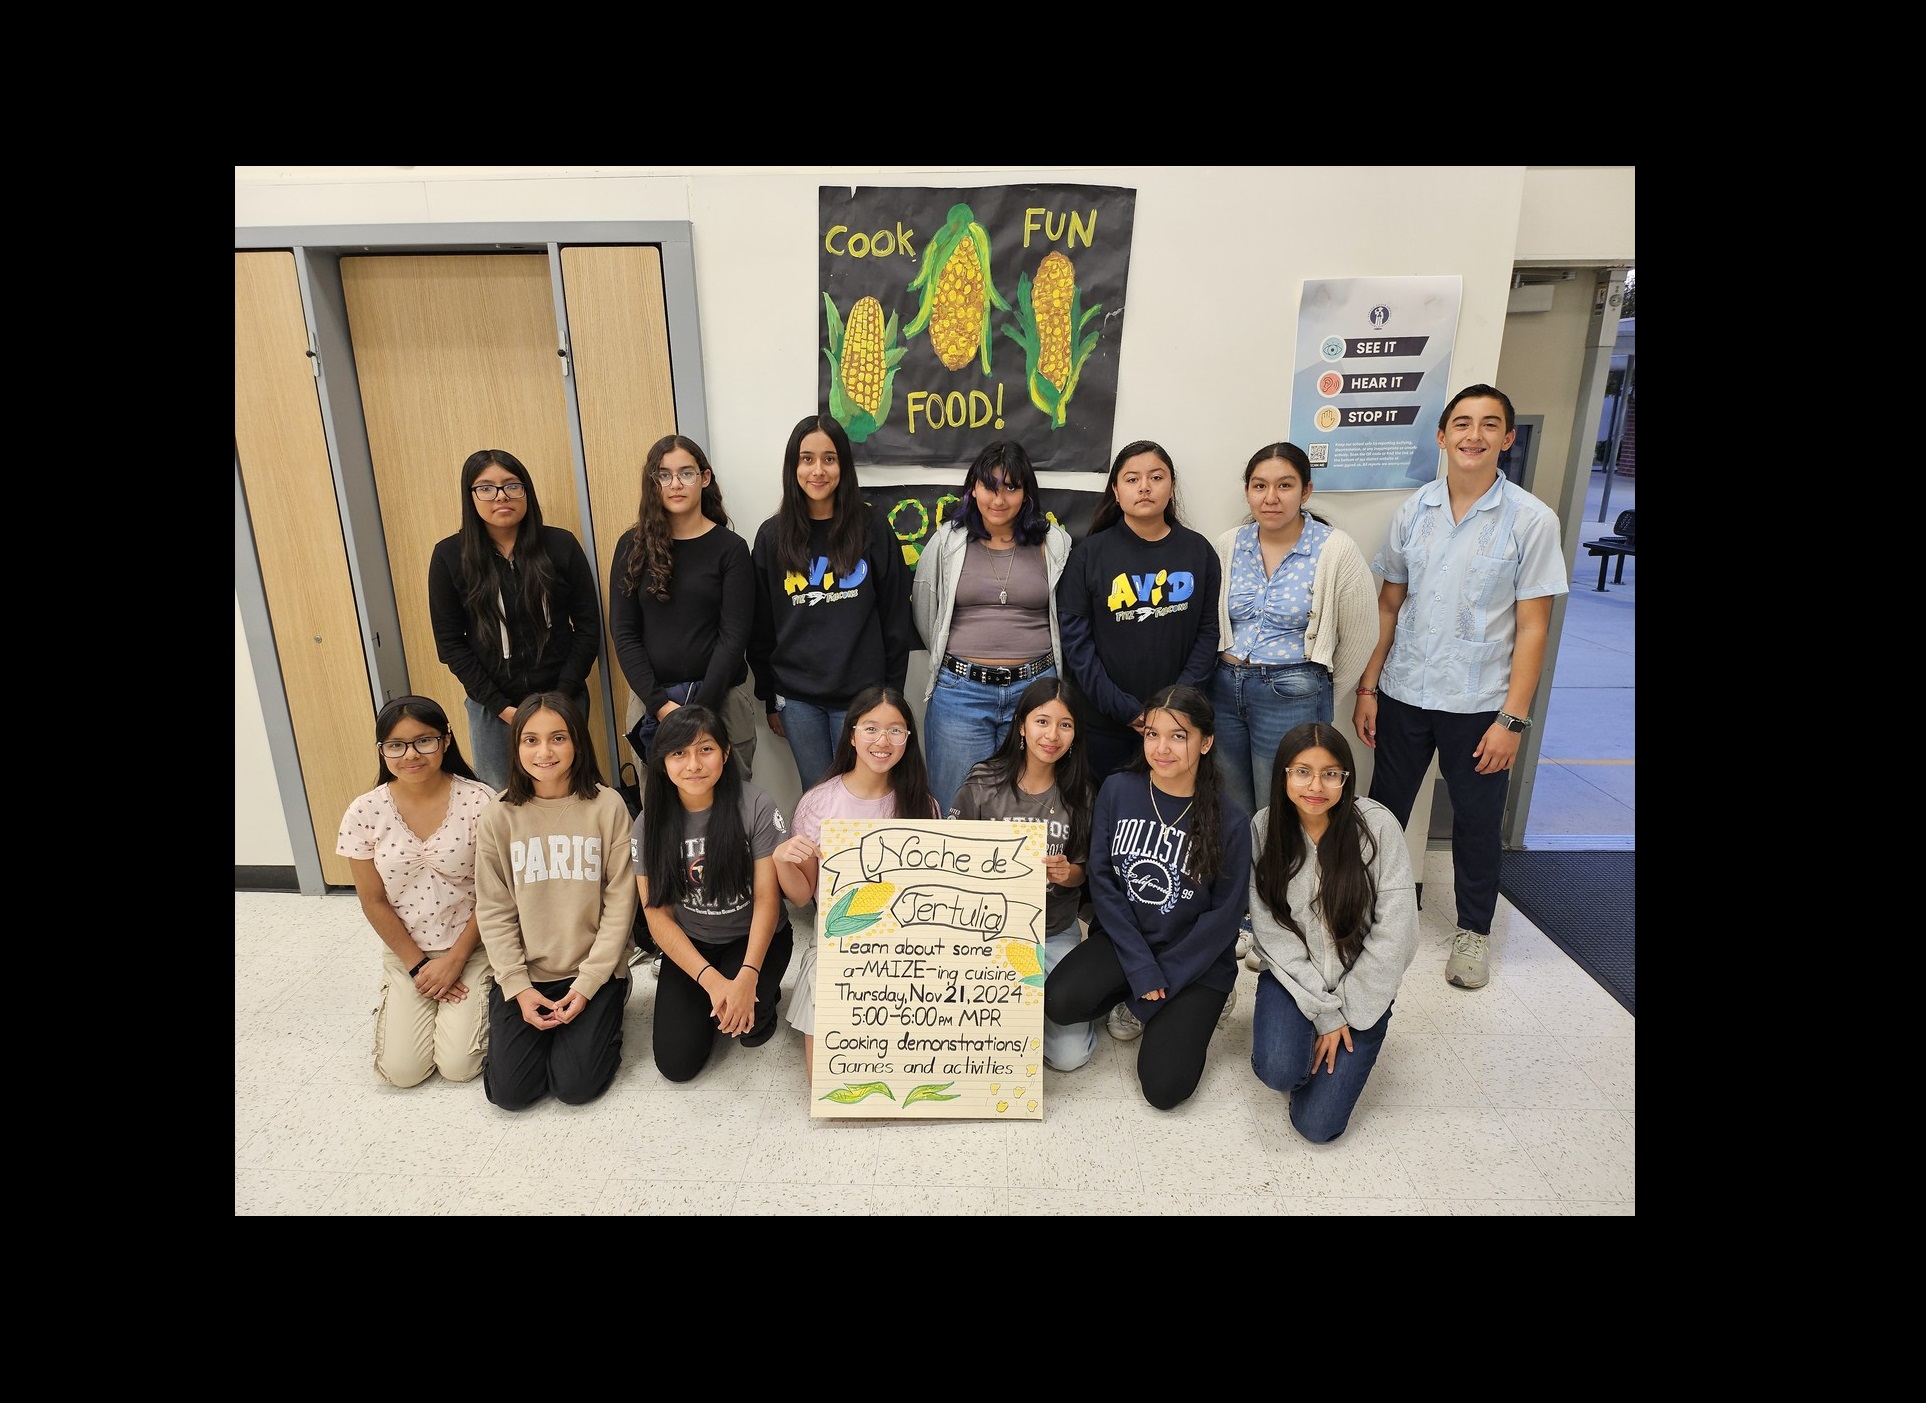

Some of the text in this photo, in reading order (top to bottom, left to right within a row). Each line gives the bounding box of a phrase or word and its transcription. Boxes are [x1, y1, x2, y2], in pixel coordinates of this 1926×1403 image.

[825, 221, 916, 257] COOK
[1023, 208, 1097, 248] FUN
[1356, 341, 1397, 354] SEE IT
[1351, 376, 1403, 389] HEAR IT
[907, 383, 1005, 434] FOOD!
[1348, 410, 1398, 423] STOP IT
[510, 834, 602, 886] PARIS
[867, 835, 1007, 874] Noche de
[1180, 888, 1194, 900] 99
[902, 892, 1002, 931] Tertulia
[839, 937, 993, 957] Learn about some
[843, 960, 1017, 986] a-MAIZE-ing cuisine
[834, 983, 1023, 1009] Thursday, Nov 21, 2024
[958, 1008, 1002, 1028] MPR
[825, 1031, 1029, 1059] Cooking demonstrations!
[828, 1054, 1014, 1075] Games and activities
